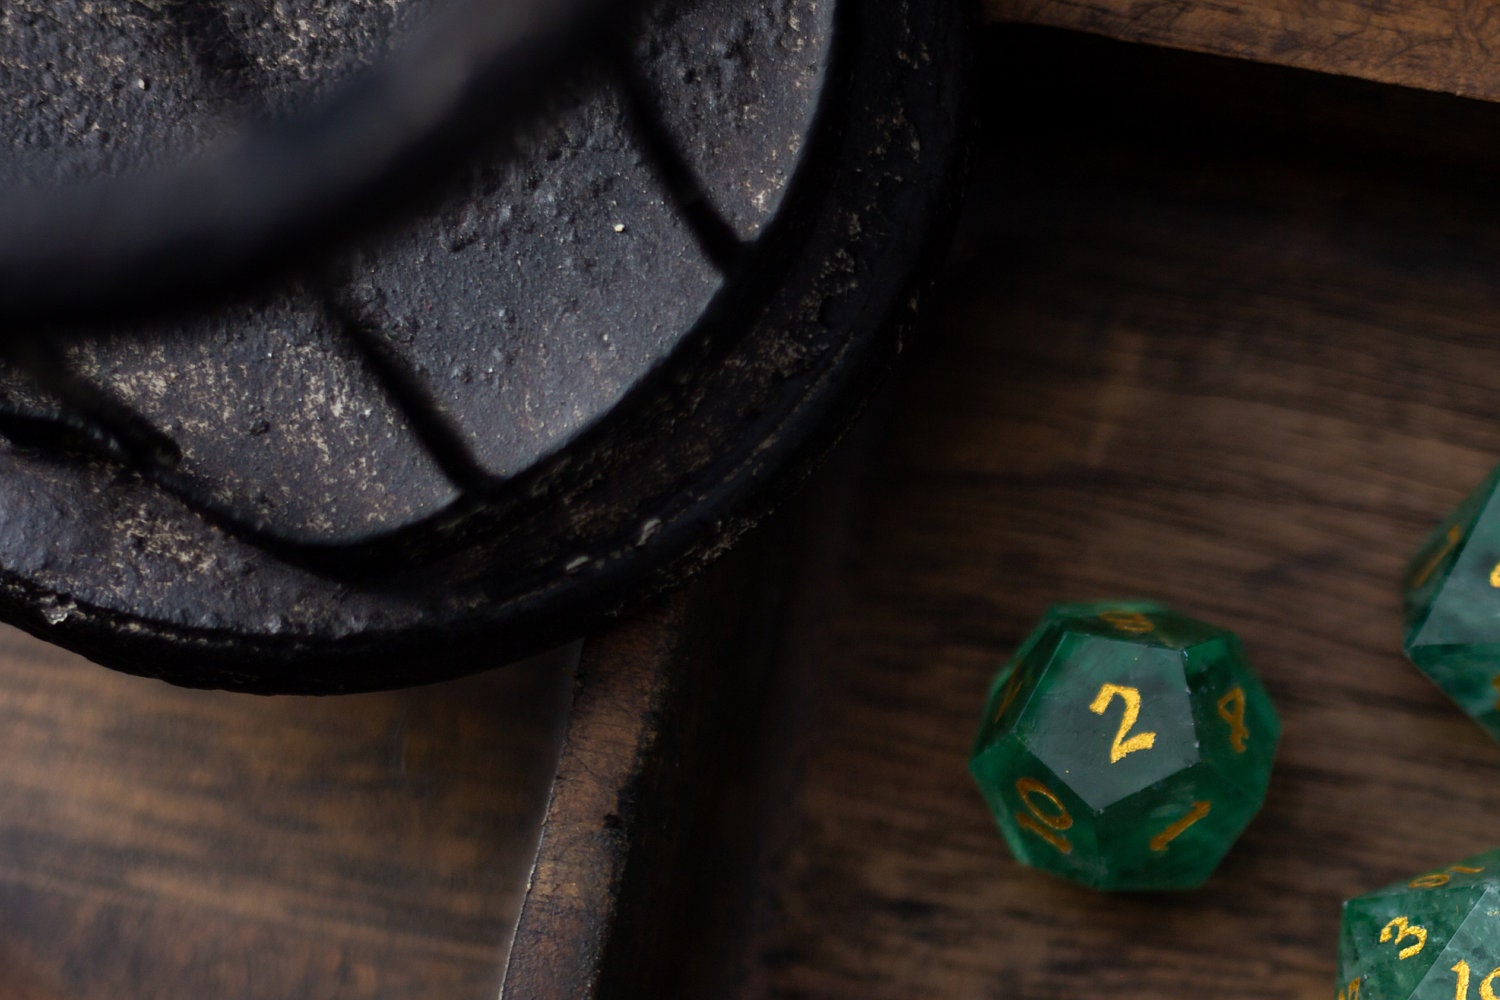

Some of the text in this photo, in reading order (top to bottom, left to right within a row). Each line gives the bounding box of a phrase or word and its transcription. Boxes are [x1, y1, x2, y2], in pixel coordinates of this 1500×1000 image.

[1089, 683, 1156, 764] 2
[1015, 778, 1073, 854] 10
[1150, 801, 1211, 851] 1
[1379, 916, 1428, 960] 3
